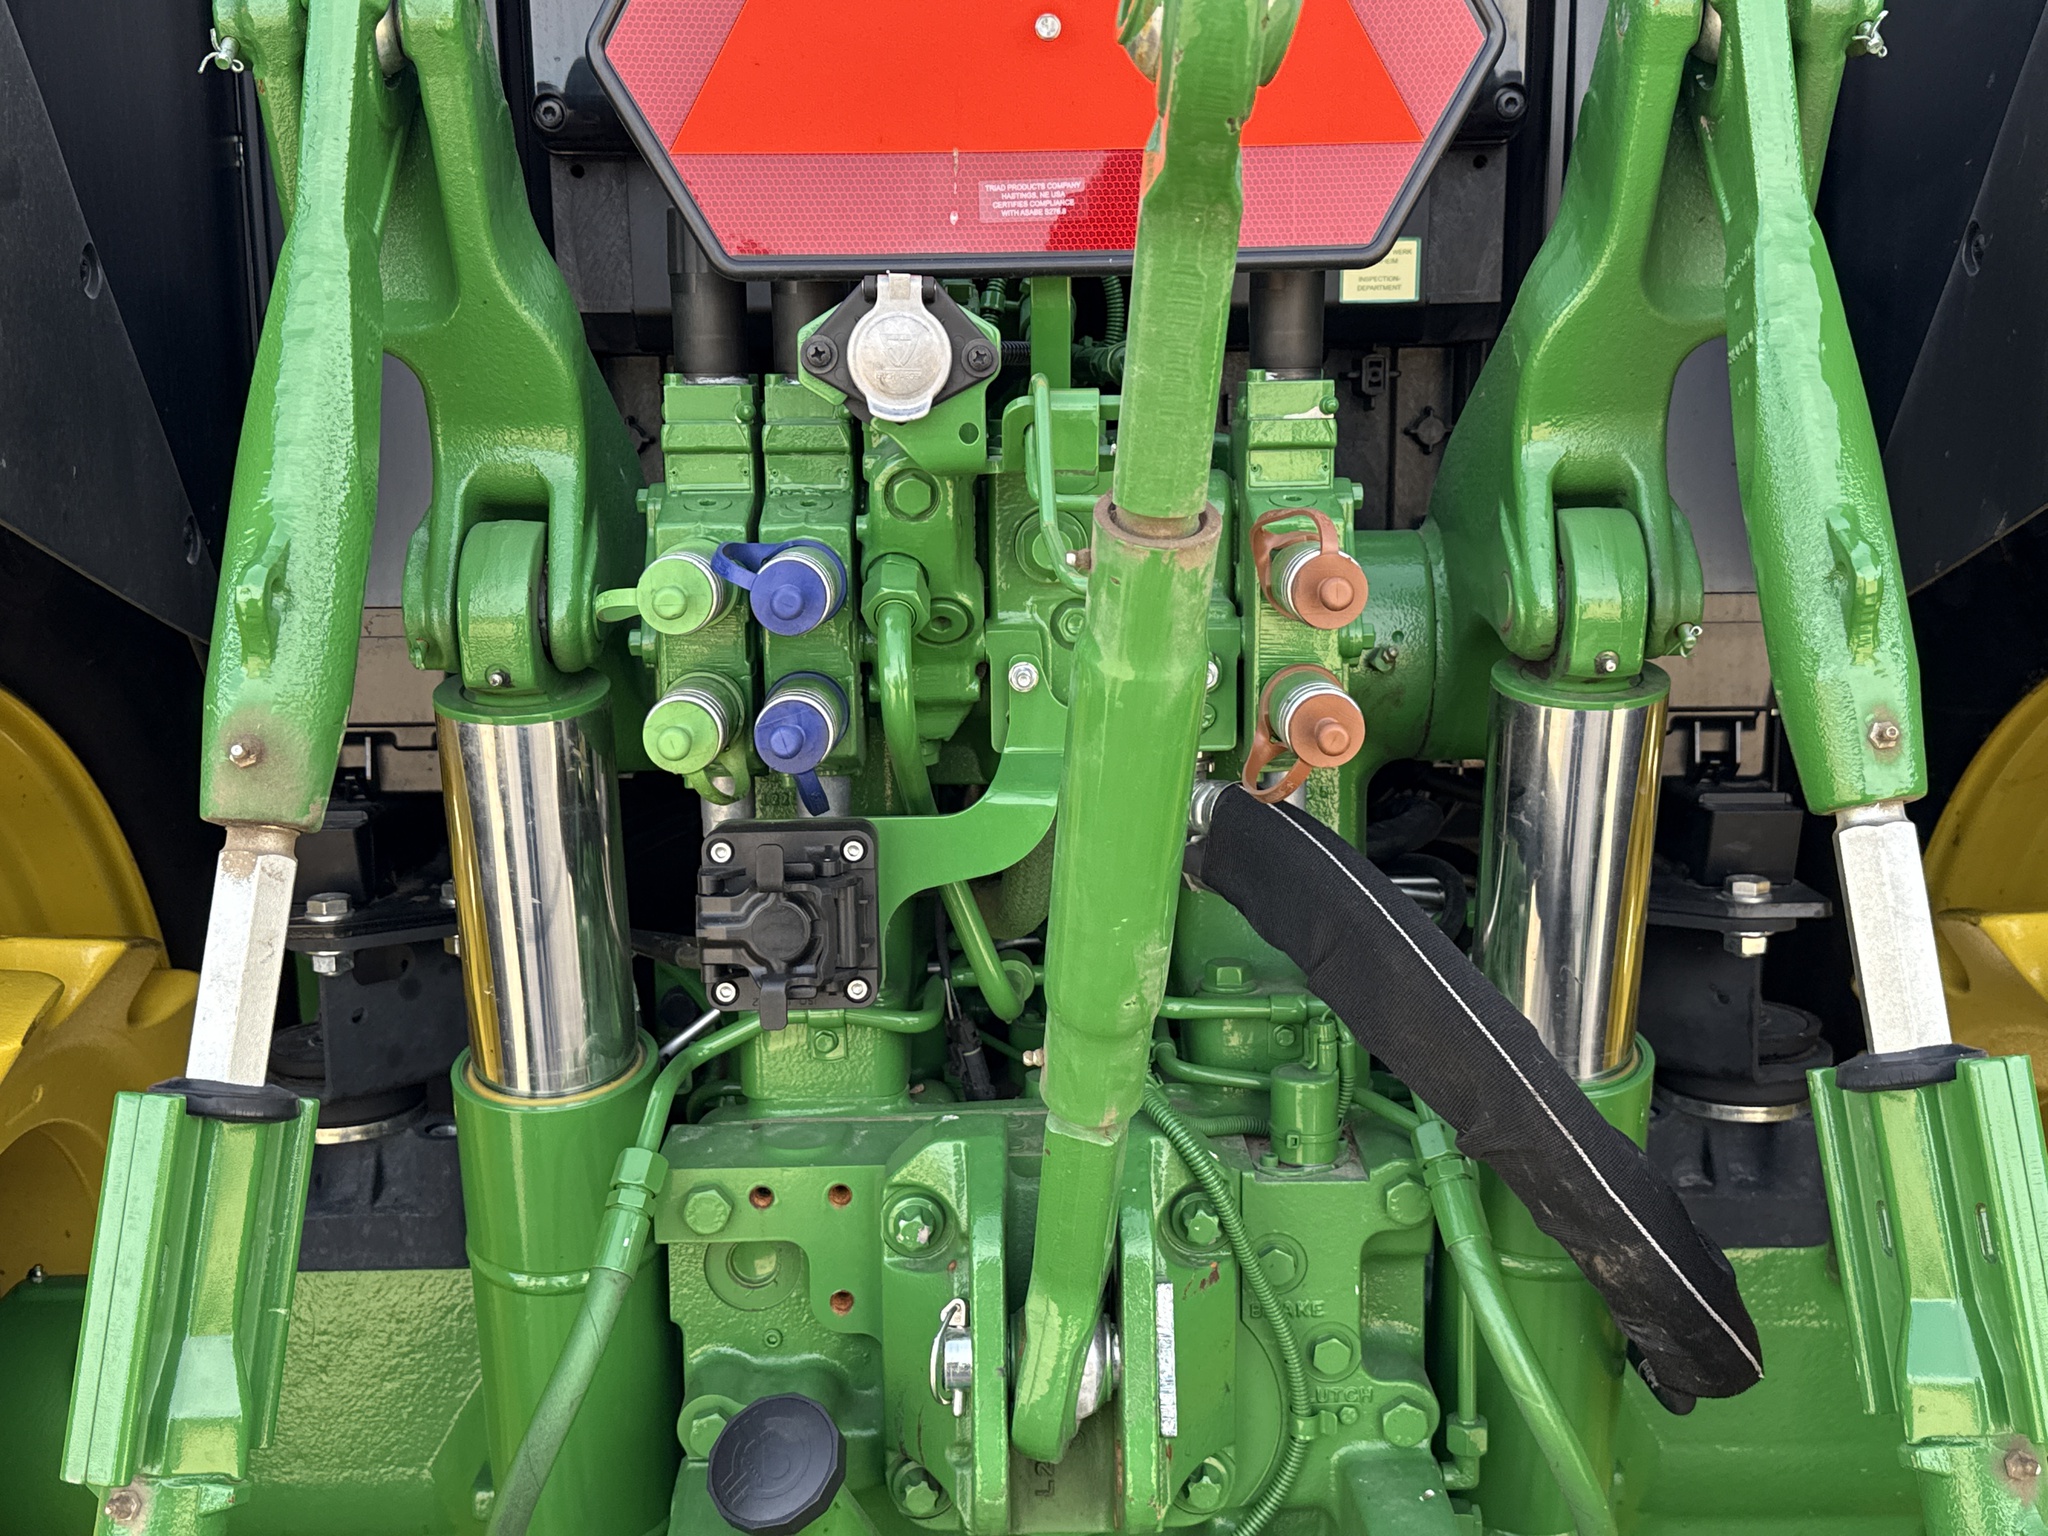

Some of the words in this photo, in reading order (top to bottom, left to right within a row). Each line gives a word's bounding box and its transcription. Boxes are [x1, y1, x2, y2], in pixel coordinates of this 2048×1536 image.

[985, 184, 1006, 192] TRIAD
[1007, 183, 1046, 191] PRODUCTS
[1048, 182, 1082, 190] COMPANY
[1051, 191, 1066, 199] USA
[992, 201, 1029, 209] CERTIFIES
[1030, 199, 1075, 208] COMPLIANCE
[1001, 209, 1020, 217] WITH
[1020, 208, 1043, 217] ASABE
[1357, 284, 1402, 292] DEPARTMENT
[1249, 1299, 1325, 1318] BAKE
